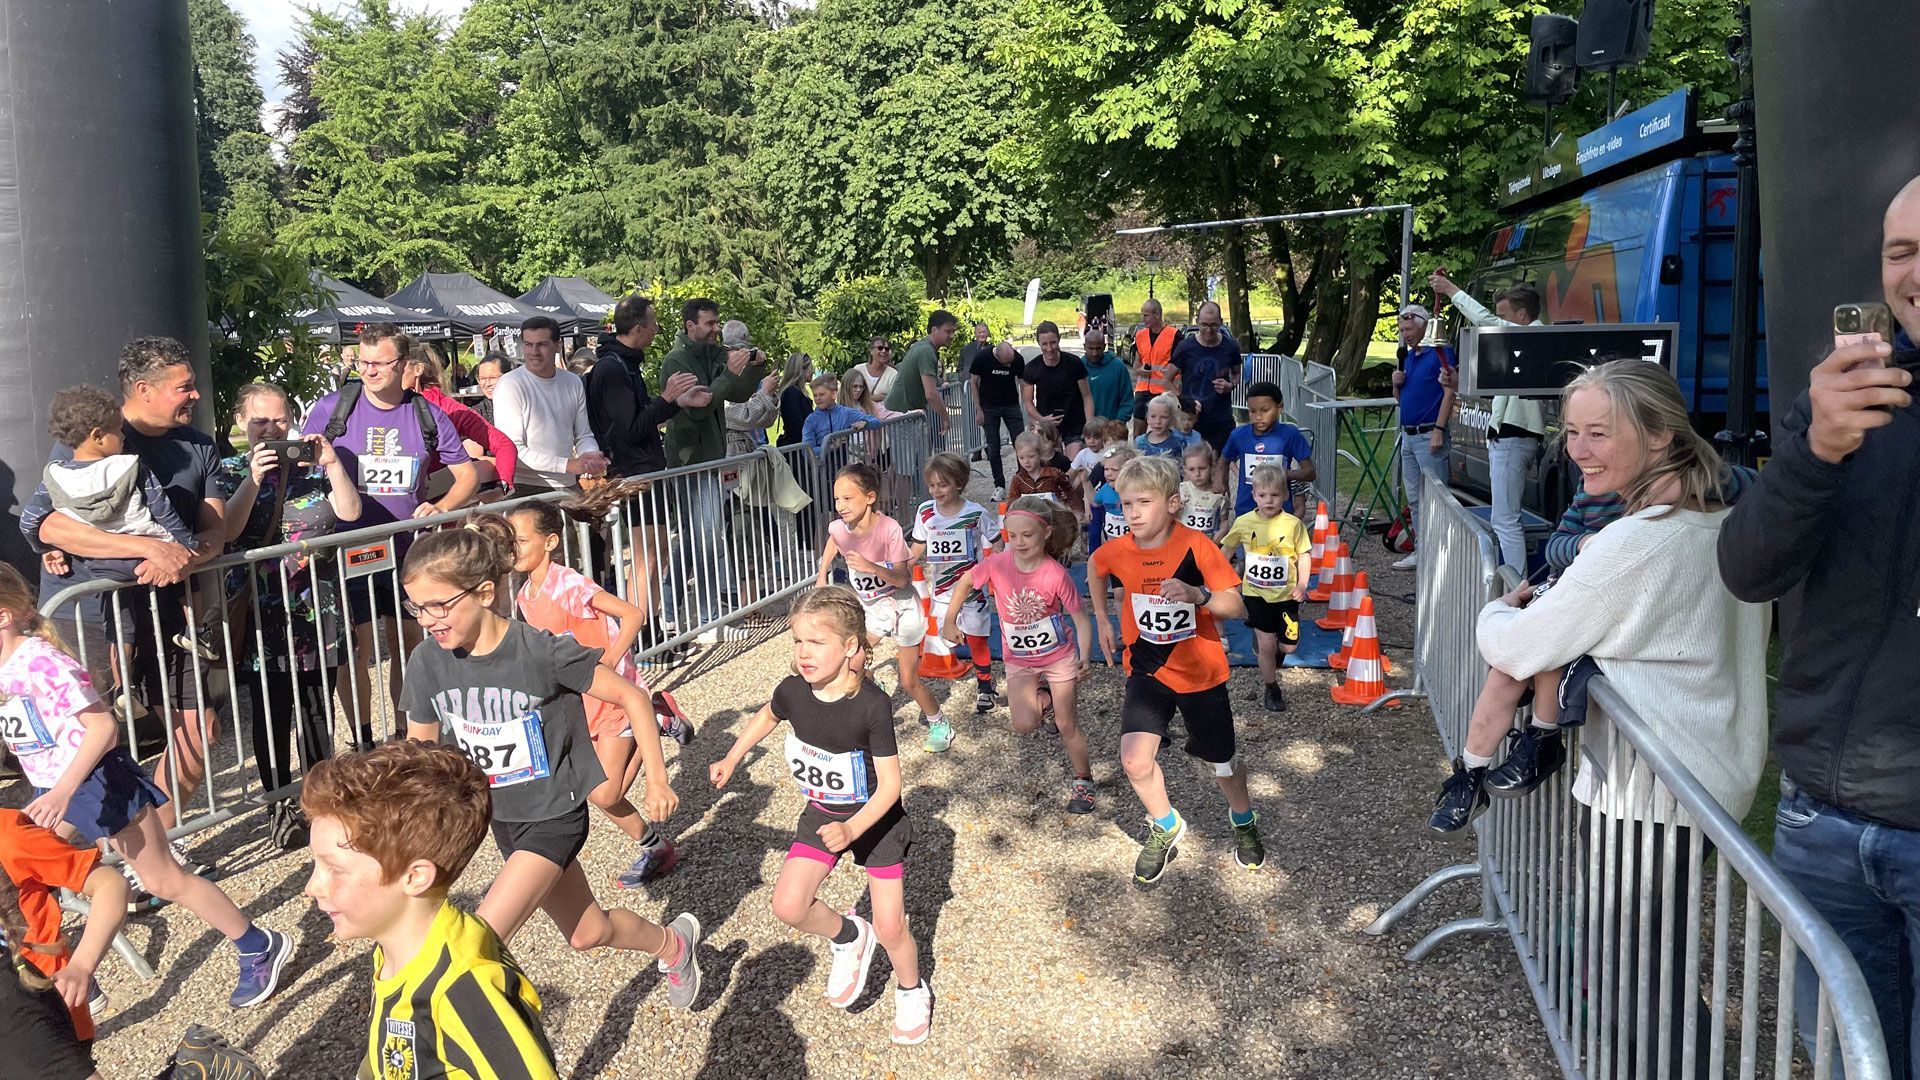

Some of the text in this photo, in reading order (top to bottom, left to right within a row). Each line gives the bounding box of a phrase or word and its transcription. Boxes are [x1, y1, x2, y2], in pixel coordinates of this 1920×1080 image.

[1639, 113, 1671, 138] Certificaat
[365, 469, 404, 484] 221
[1107, 523, 1130, 536] 218
[1187, 515, 1214, 528] 335
[932, 540, 963, 554] 382
[1248, 564, 1285, 580] 488
[854, 576, 887, 591] 320
[1138, 609, 1190, 632] 452
[1010, 631, 1052, 649] 262
[792, 758, 844, 790] 286
[389, 1020, 413, 1036] VITESSE
